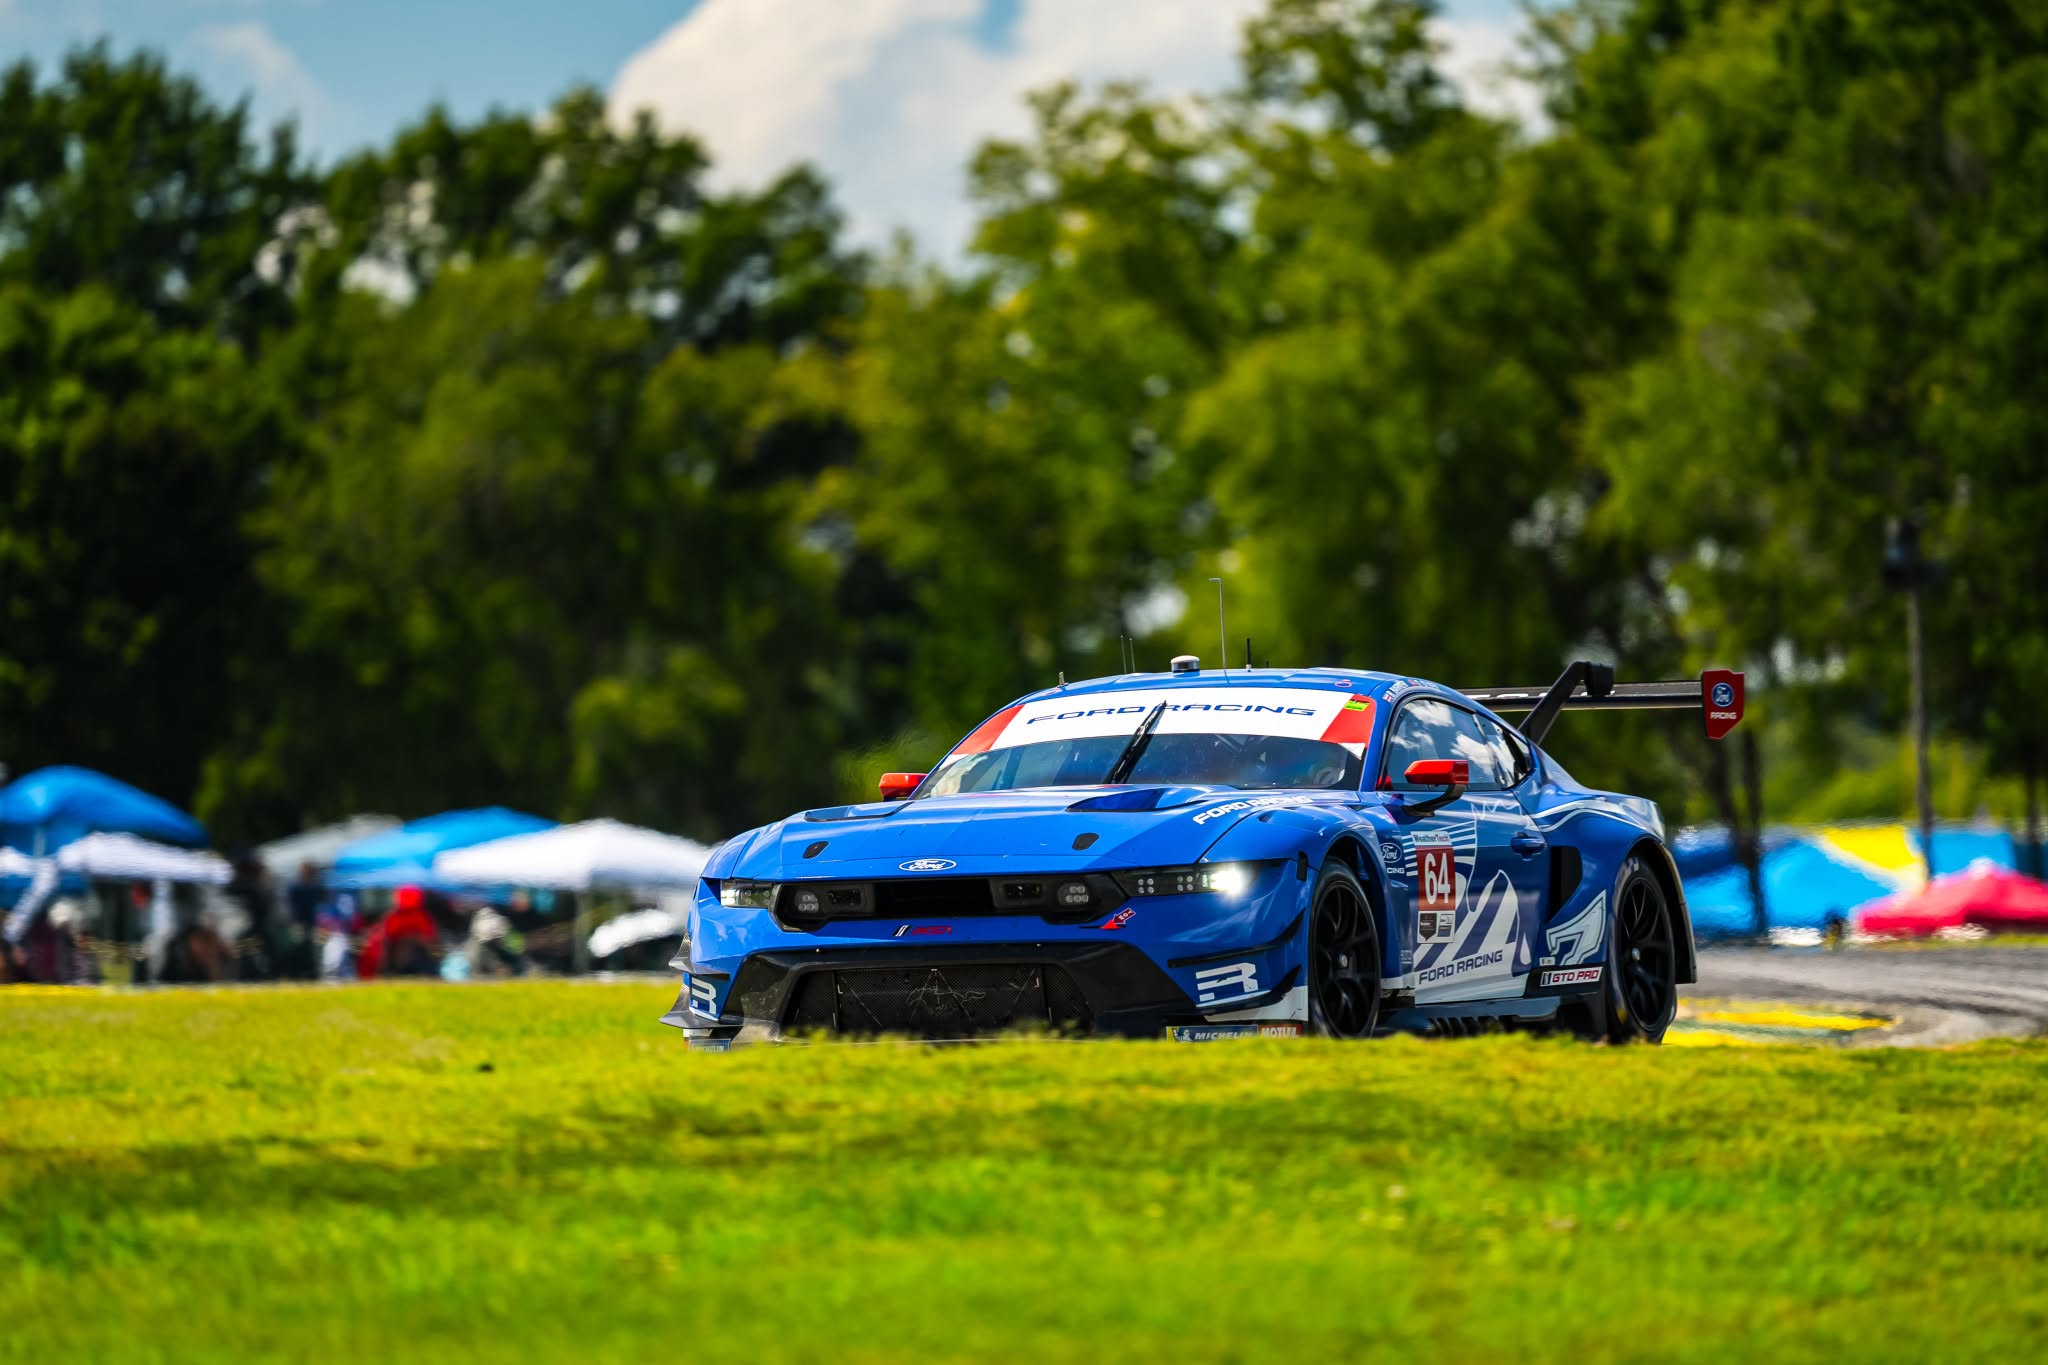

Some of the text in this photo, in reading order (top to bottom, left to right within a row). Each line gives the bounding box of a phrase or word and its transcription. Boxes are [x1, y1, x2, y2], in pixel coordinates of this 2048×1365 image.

[1027, 704, 1317, 724] FORD RACING
[1193, 801, 1249, 825] FORD
[1381, 844, 1399, 861] Ford
[906, 859, 950, 871] Ford
[1424, 852, 1451, 905] 64
[1419, 950, 1503, 985] FORD RACING
[1552, 969, 1600, 983] GTD PRO
[1261, 1027, 1298, 1038] MOTUL
